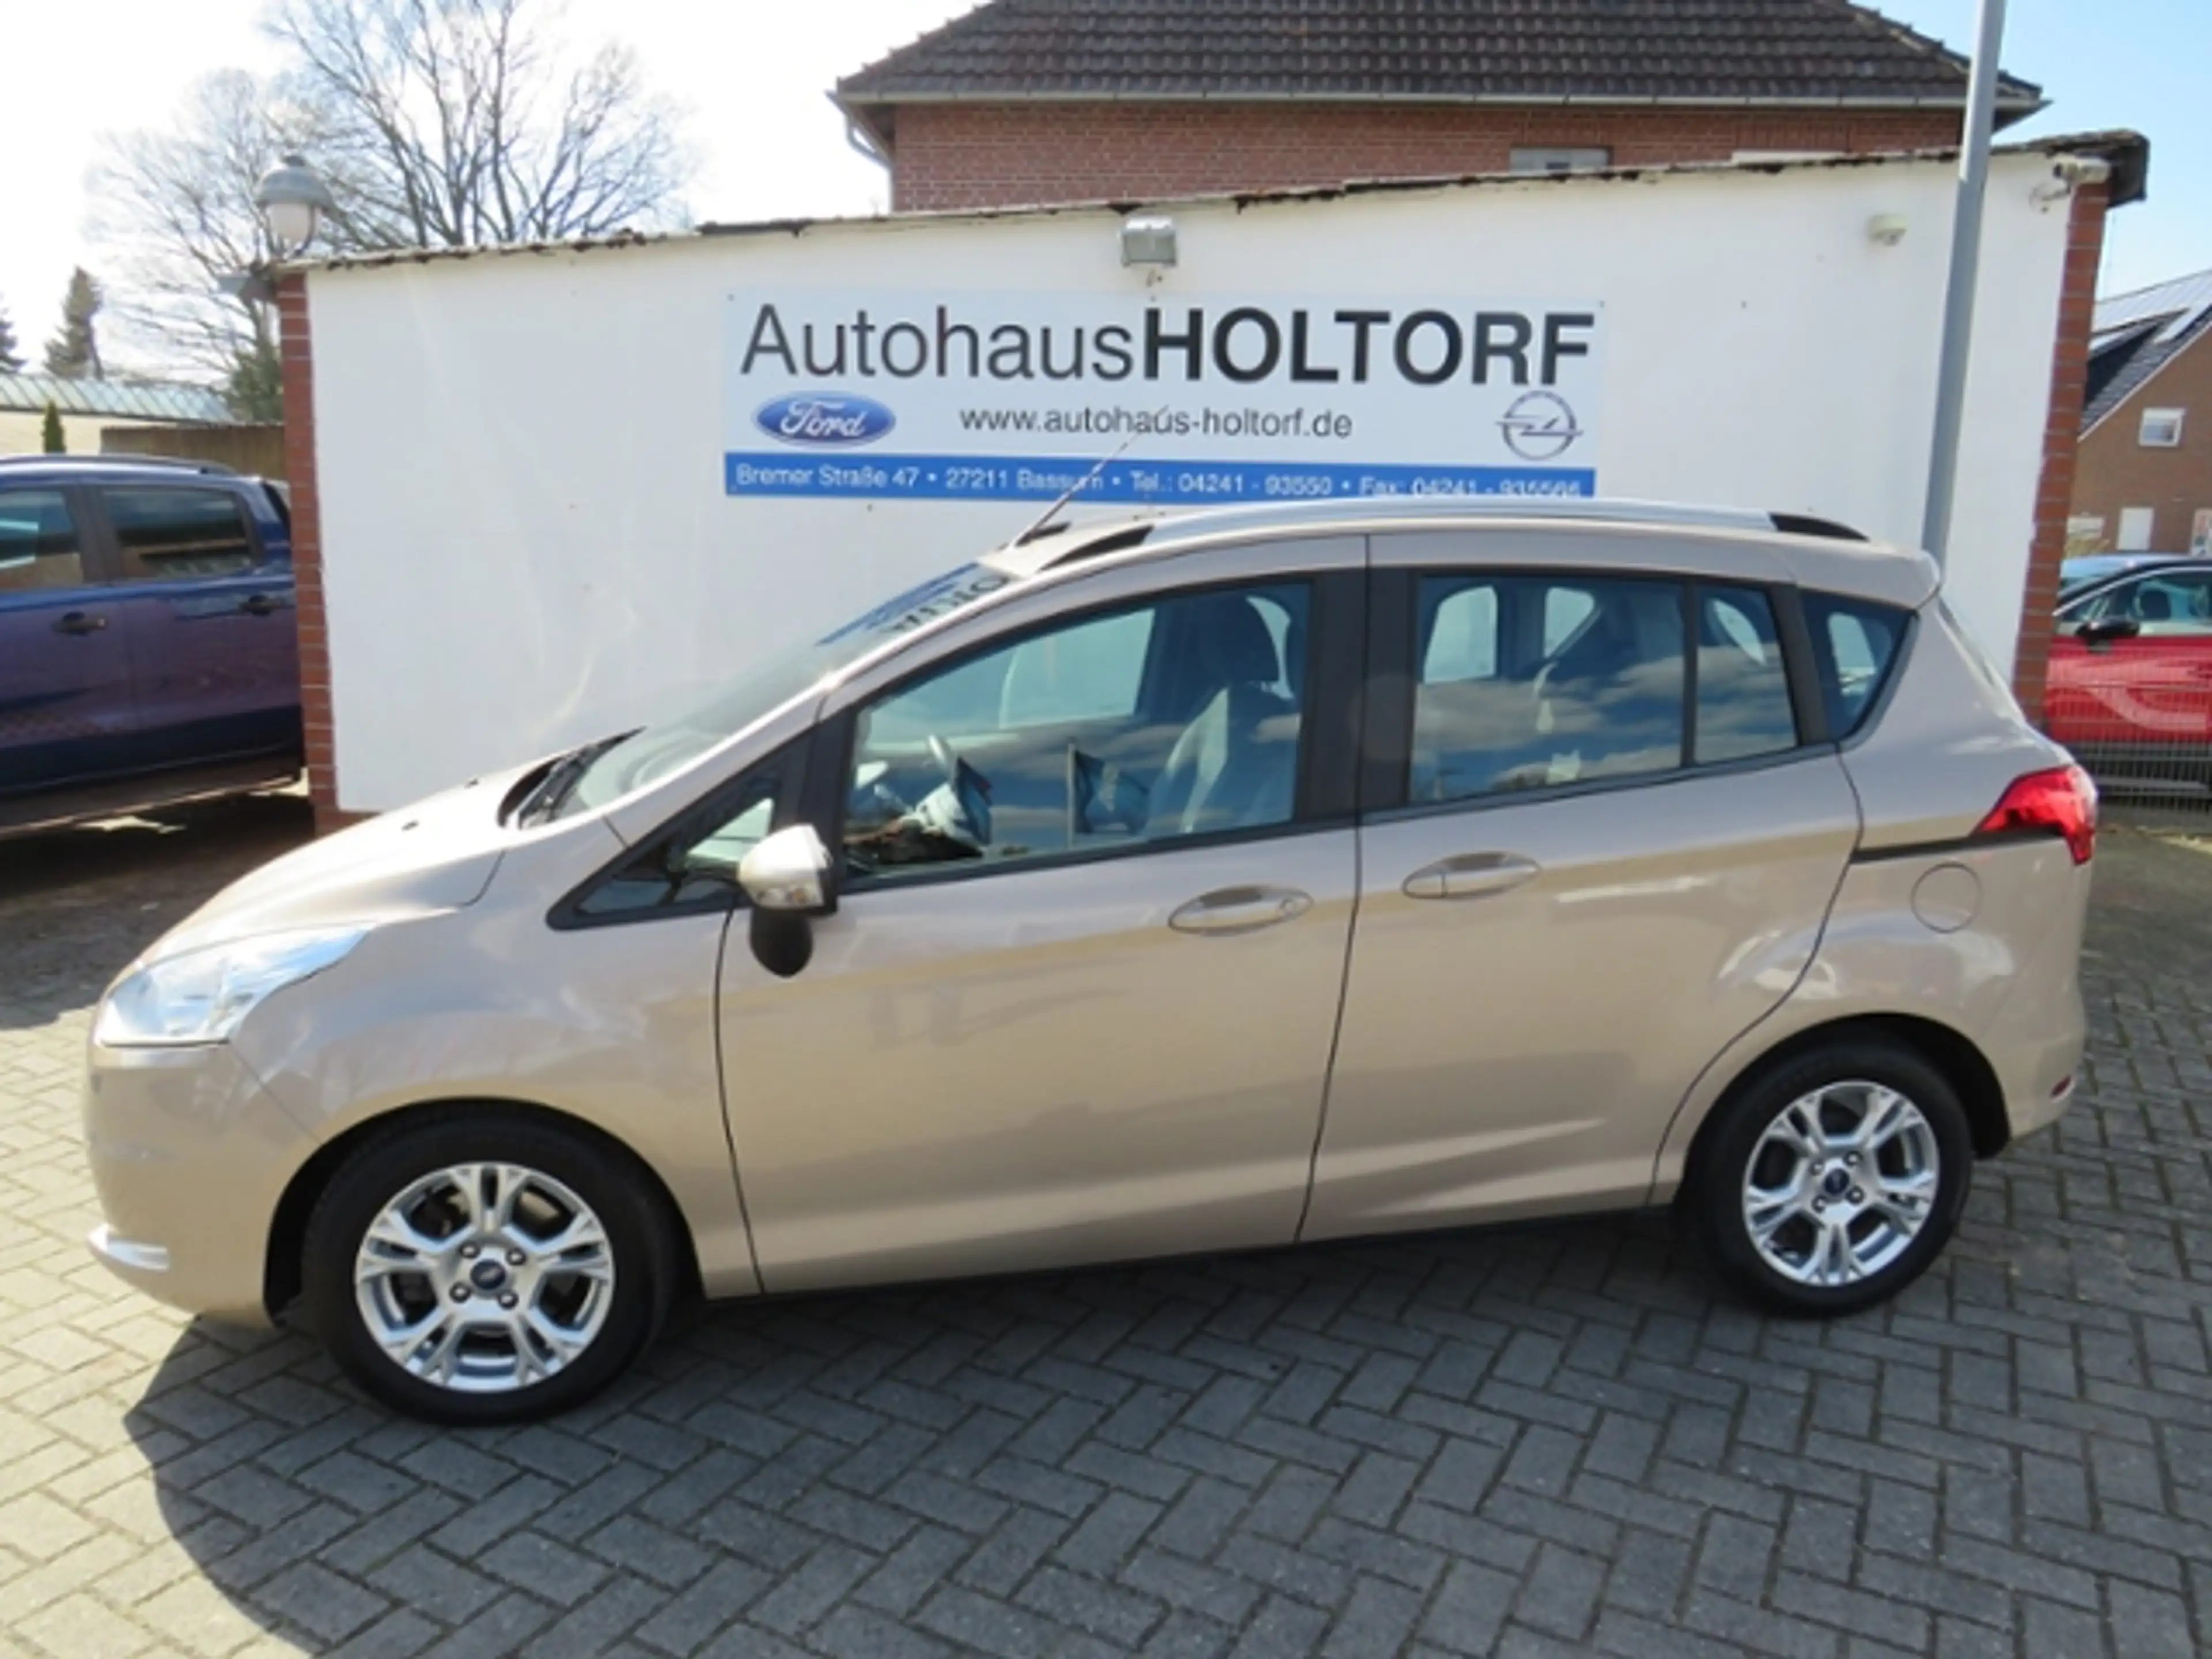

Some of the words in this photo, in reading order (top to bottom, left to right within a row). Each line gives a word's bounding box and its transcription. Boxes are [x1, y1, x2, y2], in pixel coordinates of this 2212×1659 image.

[781, 401, 868, 437] Ford
[959, 407, 1352, 437] www.autohaus-holtorf.de
[735, 462, 813, 485] Bremer
[818, 463, 888, 488] Straße
[892, 466, 920, 488] 47
[945, 467, 1007, 490] 27211
[1178, 472, 1243, 494] 04241
